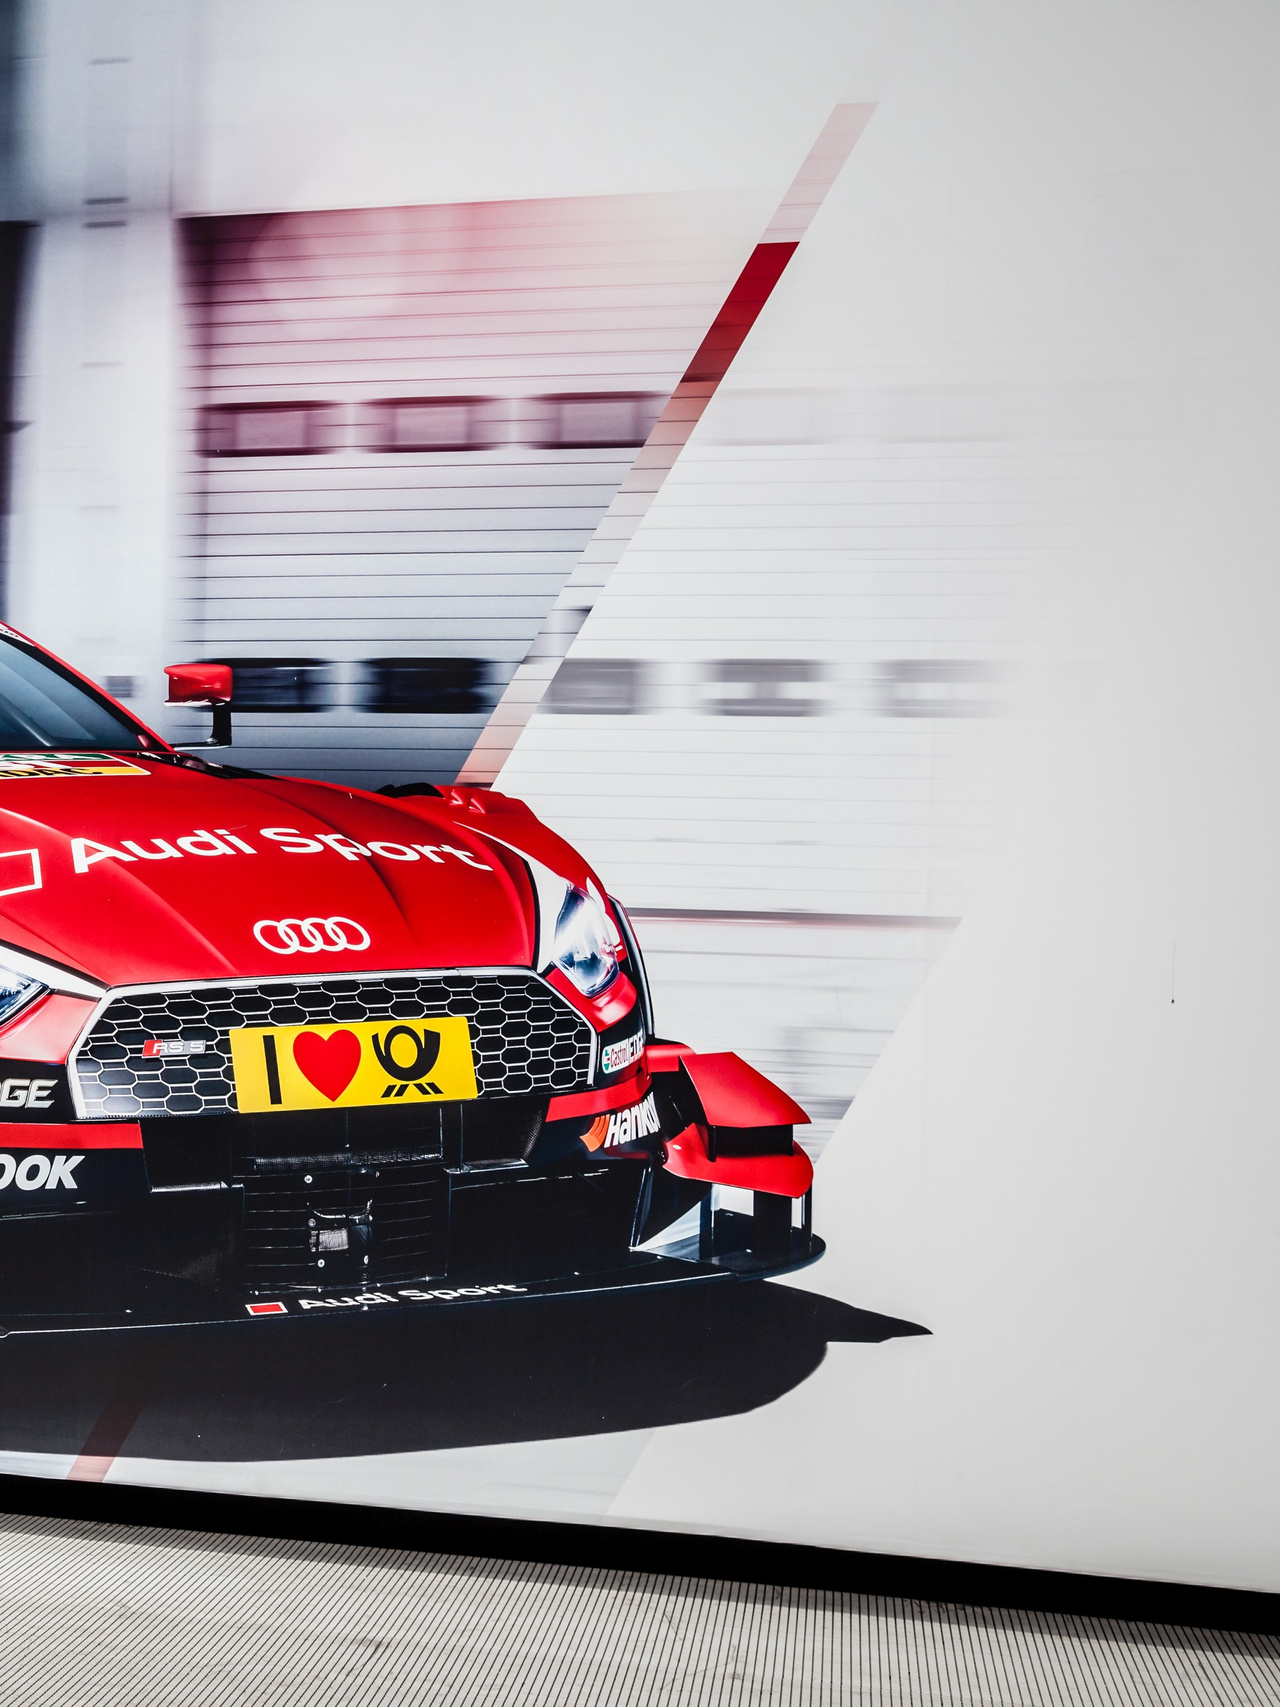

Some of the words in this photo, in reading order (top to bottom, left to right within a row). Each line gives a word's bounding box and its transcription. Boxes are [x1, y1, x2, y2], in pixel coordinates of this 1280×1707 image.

[71, 828, 257, 874] Audi
[260, 827, 494, 871] Sport
[153, 1042, 184, 1054] RS
[190, 1041, 204, 1052] 5
[262, 1035, 283, 1105] I
[298, 1292, 399, 1310] Audi
[398, 1283, 528, 1301] Sport
